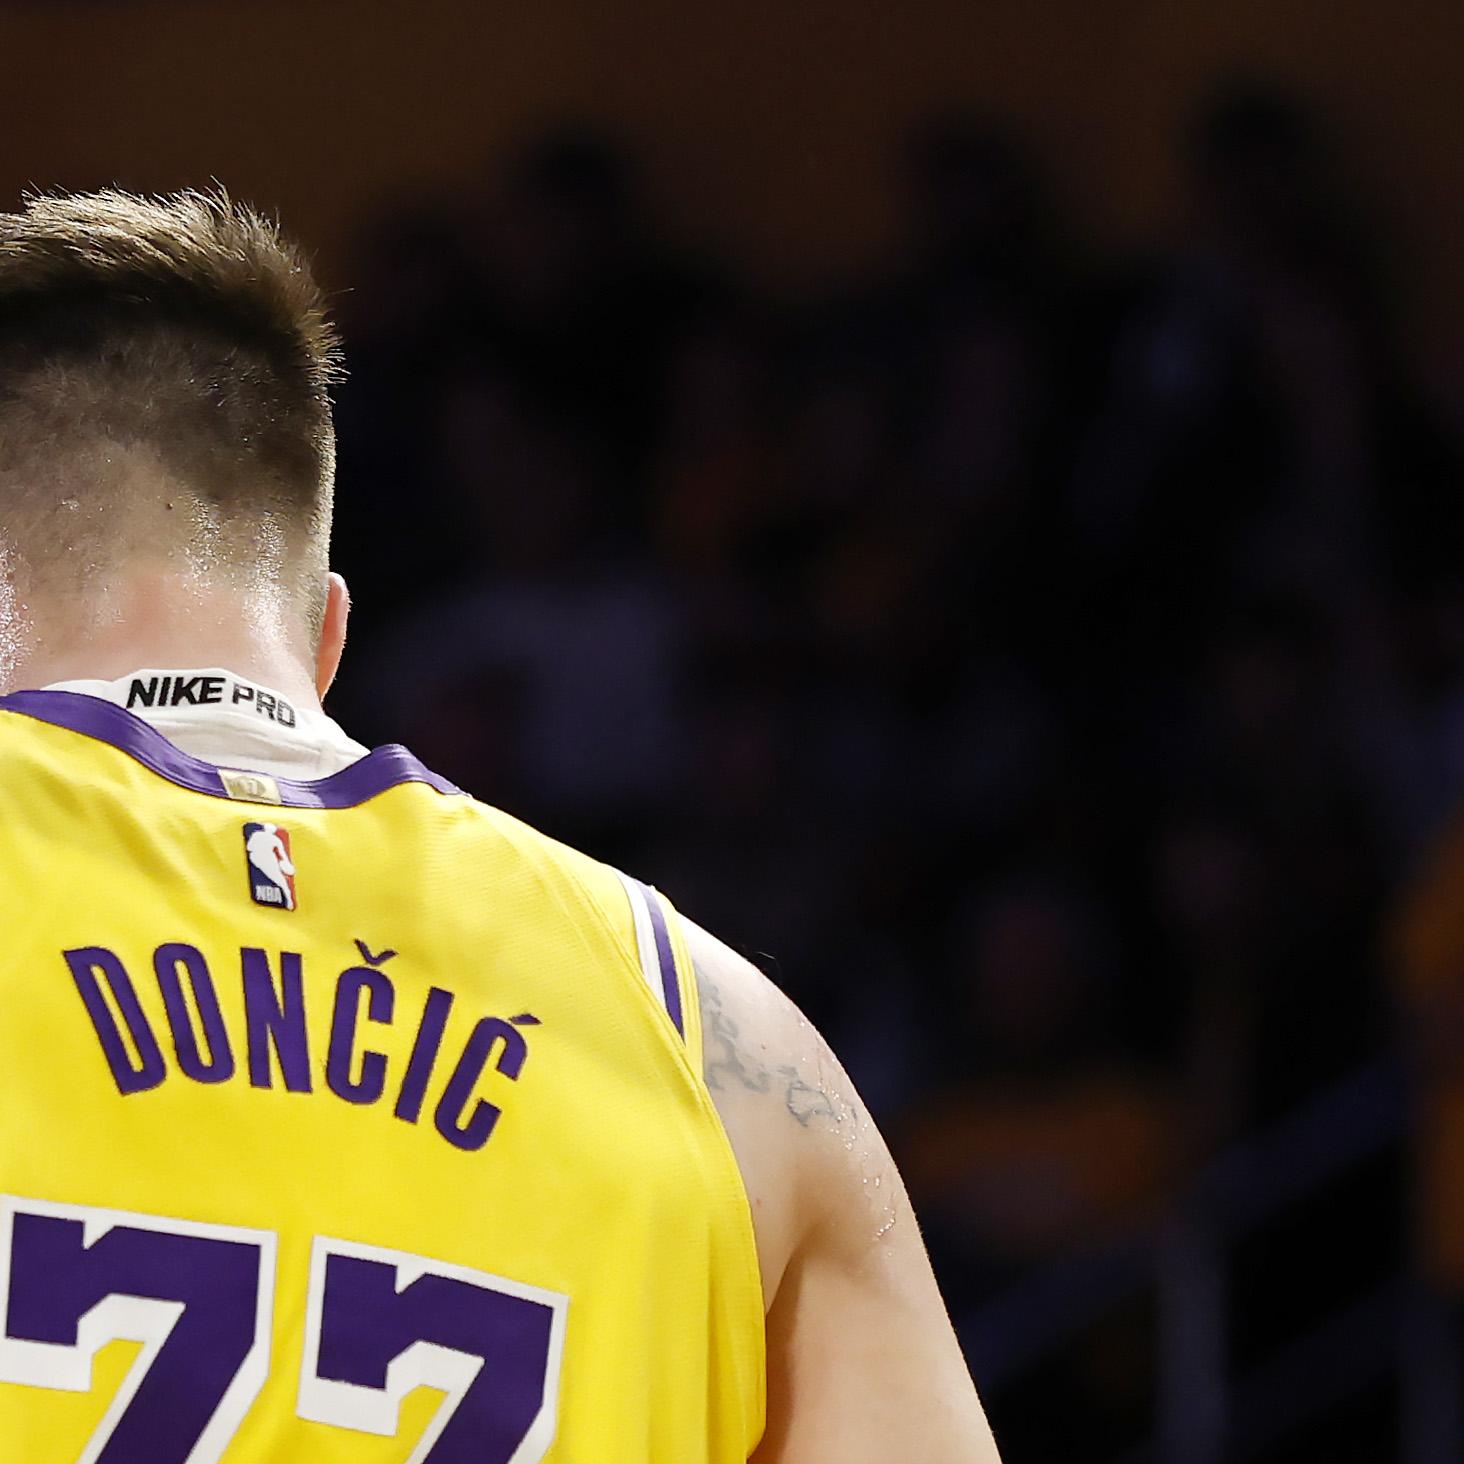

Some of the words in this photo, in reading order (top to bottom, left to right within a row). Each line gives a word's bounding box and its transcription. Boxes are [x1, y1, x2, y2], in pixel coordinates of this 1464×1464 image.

[126, 677, 225, 709] NIKE
[232, 683, 296, 728] PRO
[255, 886, 283, 904] NBA
[63, 939, 542, 1152] DONČIĆ
